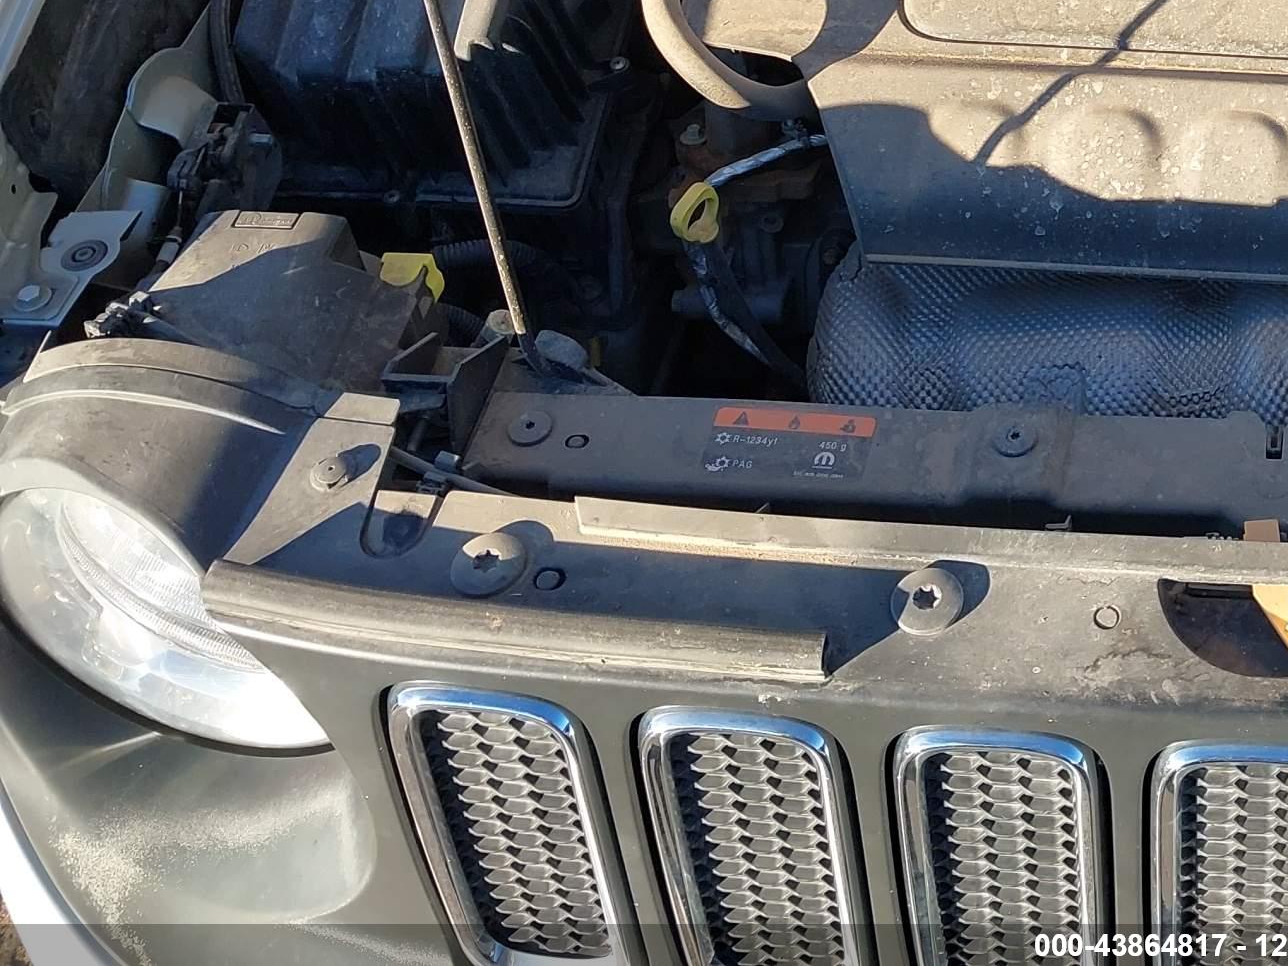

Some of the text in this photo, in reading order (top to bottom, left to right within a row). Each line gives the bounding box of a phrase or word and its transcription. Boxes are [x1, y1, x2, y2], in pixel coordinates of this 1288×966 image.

[819, 441, 847, 452] 450 g
[732, 459, 753, 469] PAG
